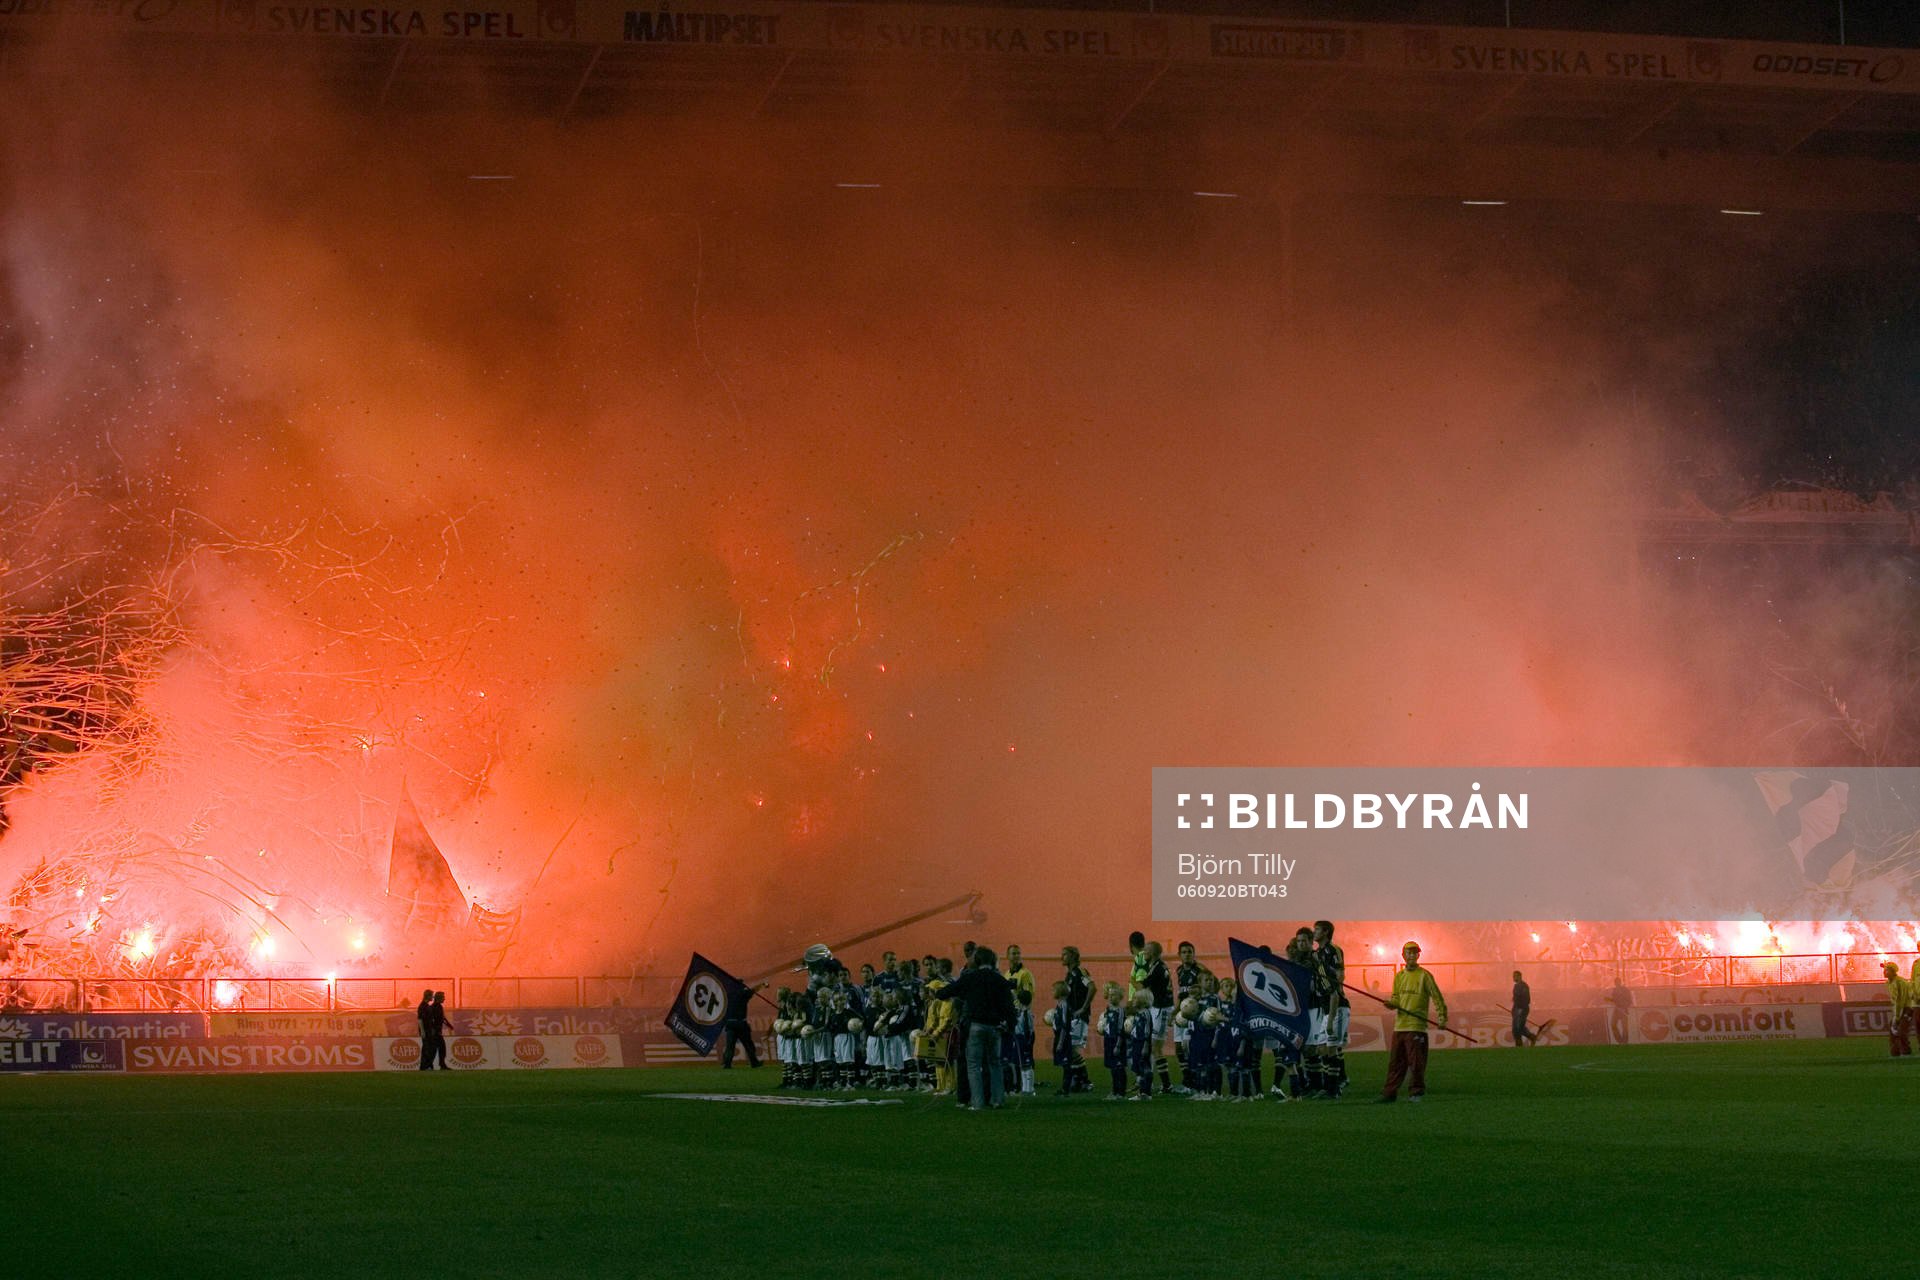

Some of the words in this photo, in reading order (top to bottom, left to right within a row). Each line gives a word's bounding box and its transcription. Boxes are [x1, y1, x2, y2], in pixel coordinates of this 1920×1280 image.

[267, 7, 429, 35] SVENSKA
[442, 11, 524, 38] SPEL
[623, 3, 780, 44] MÅLTIPSET
[877, 24, 1030, 53] SVENSKA
[1043, 29, 1121, 56] SPEL
[1452, 45, 1592, 74] SVENSKA
[1606, 53, 1676, 79] SPEL
[1753, 54, 1869, 78] ODDSET
[43, 1020, 191, 1038] Folkpartiet
[1674, 1006, 1796, 1033] comfort
[134, 1040, 366, 1068] SVANSTRÖMS
